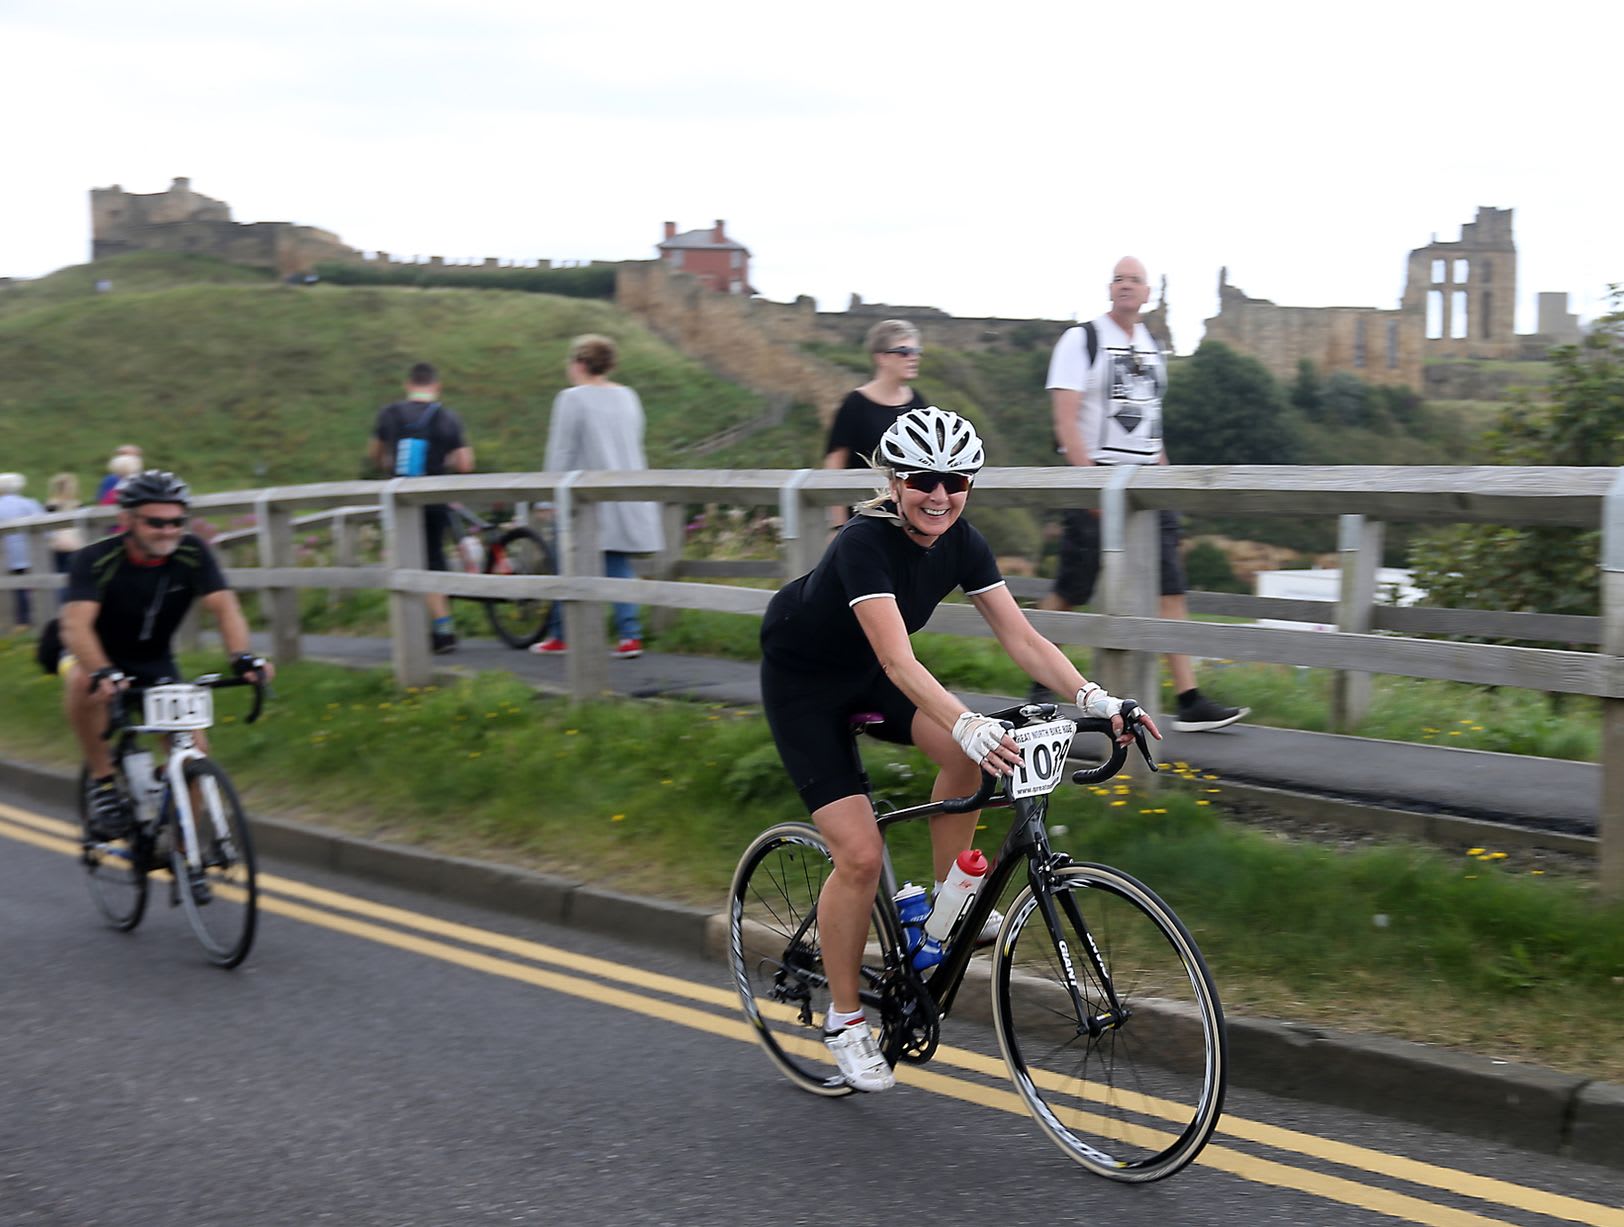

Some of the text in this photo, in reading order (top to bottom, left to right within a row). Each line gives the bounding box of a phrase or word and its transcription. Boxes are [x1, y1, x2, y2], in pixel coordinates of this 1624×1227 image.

[1032, 728, 1049, 739] NORTH
[1050, 726, 1061, 736] BIKE
[1062, 724, 1073, 734] RIDE
[1058, 939, 1077, 986] GIANT
